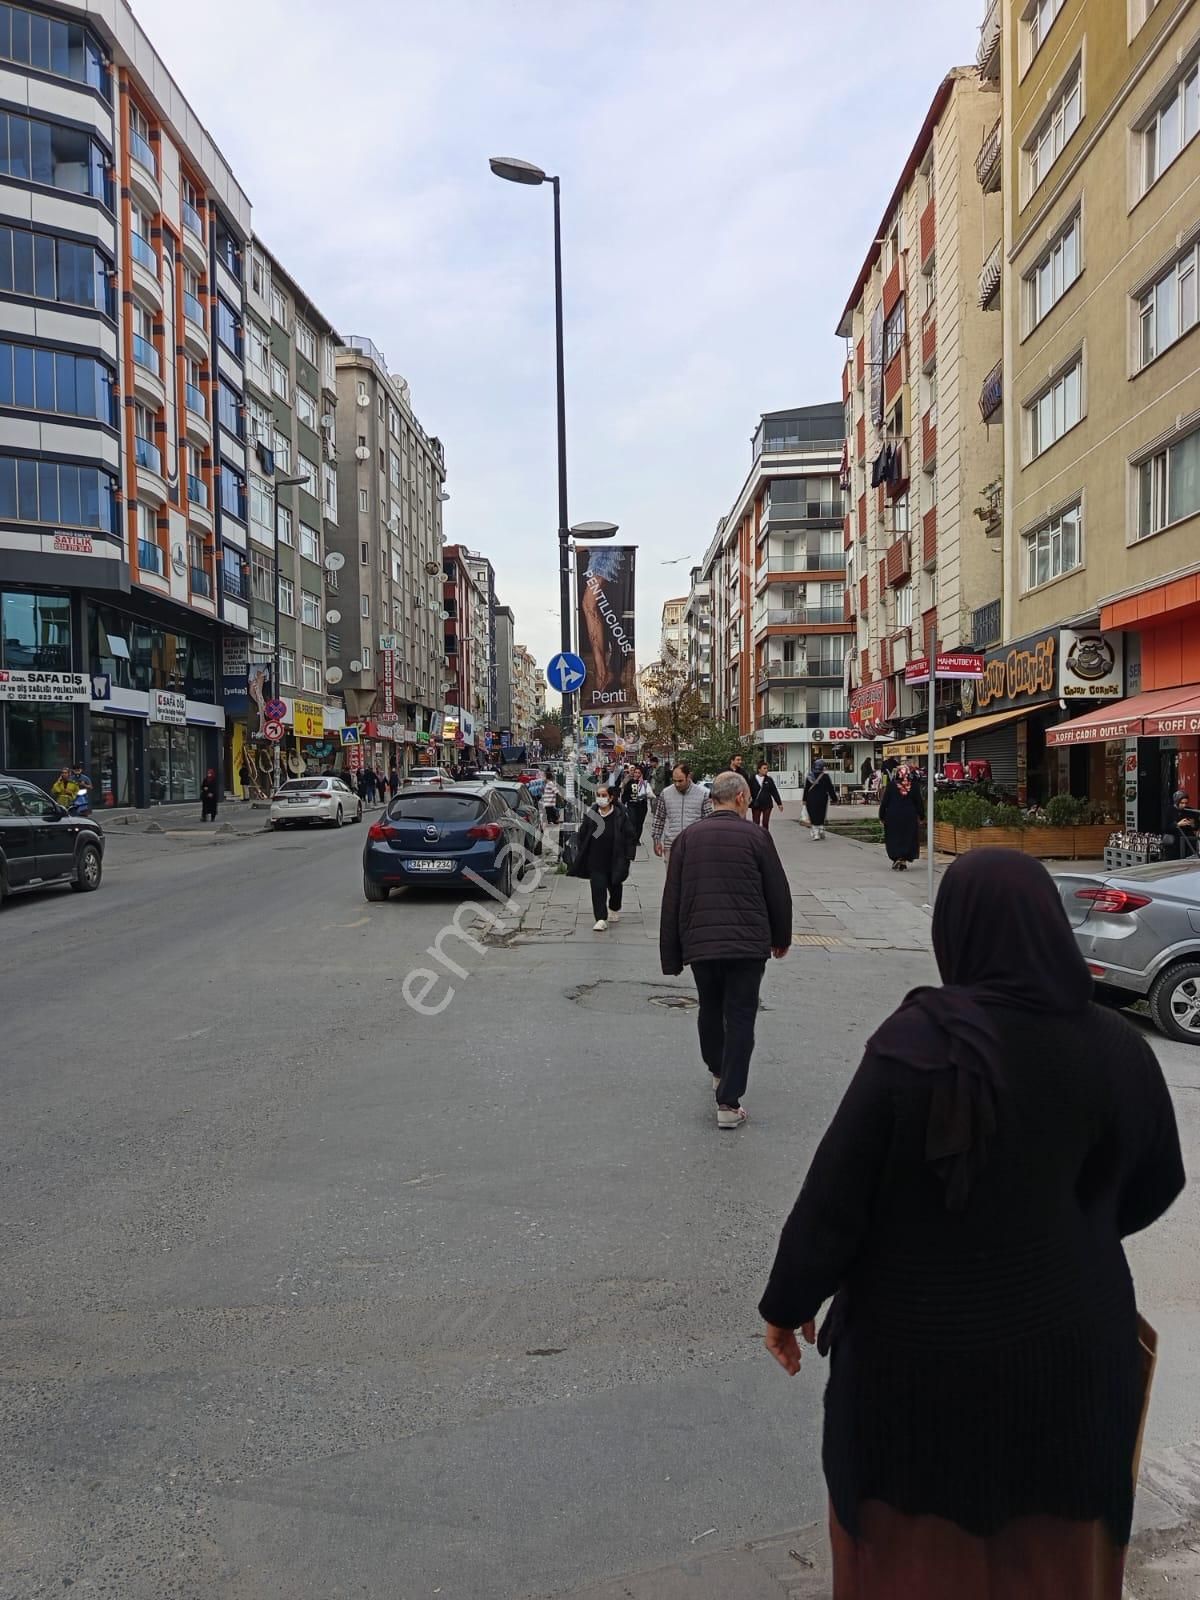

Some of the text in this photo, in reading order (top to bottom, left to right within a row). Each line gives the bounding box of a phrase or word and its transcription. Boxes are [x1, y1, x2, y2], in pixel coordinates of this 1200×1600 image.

[54, 535, 92, 546] SATILIK
[937, 658, 973, 666] MAHMUTBEY
[1006, 636, 1055, 699] CORNER
[28, 673, 60, 684] SAFA
[62, 674, 82, 685] DİŞ
[17, 684, 28, 693] DİŞ
[28, 685, 52, 693] SAĞLIĞI
[1089, 684, 1120, 695] CORNER
[592, 689, 628, 704] Penti
[1158, 716, 1186, 732] KOFFİ
[1056, 724, 1128, 742] KOFFİ ÇADIR OUTLET
